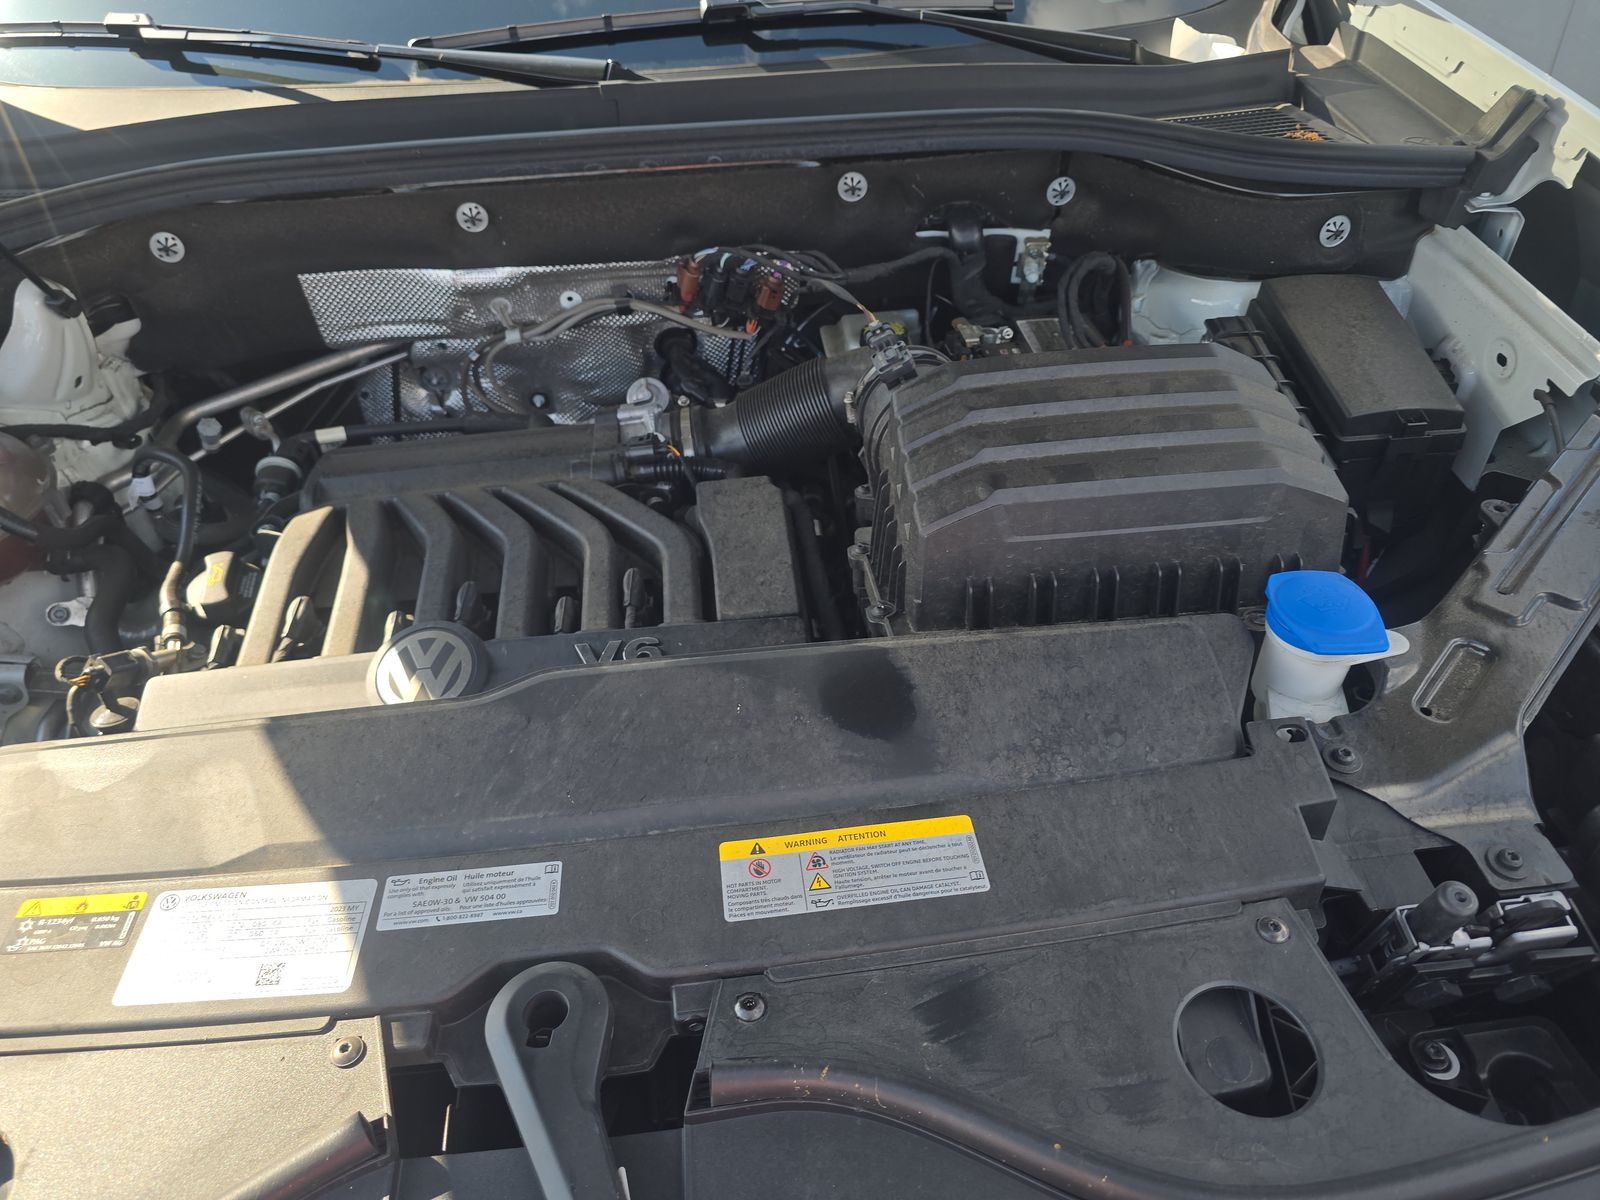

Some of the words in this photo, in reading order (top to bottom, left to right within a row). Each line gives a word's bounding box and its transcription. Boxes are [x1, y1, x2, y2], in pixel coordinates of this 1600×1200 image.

[574, 636, 664, 665] V6
[784, 837, 828, 849] WARNING
[838, 830, 886, 842] ATTENTION
[464, 872, 485, 880] Huile
[486, 870, 515, 878] moteur
[419, 876, 445, 886] Engine
[185, 891, 248, 901] VOLKSWAGEN
[836, 892, 870, 900] OVERFILLED
[346, 903, 360, 912] MY
